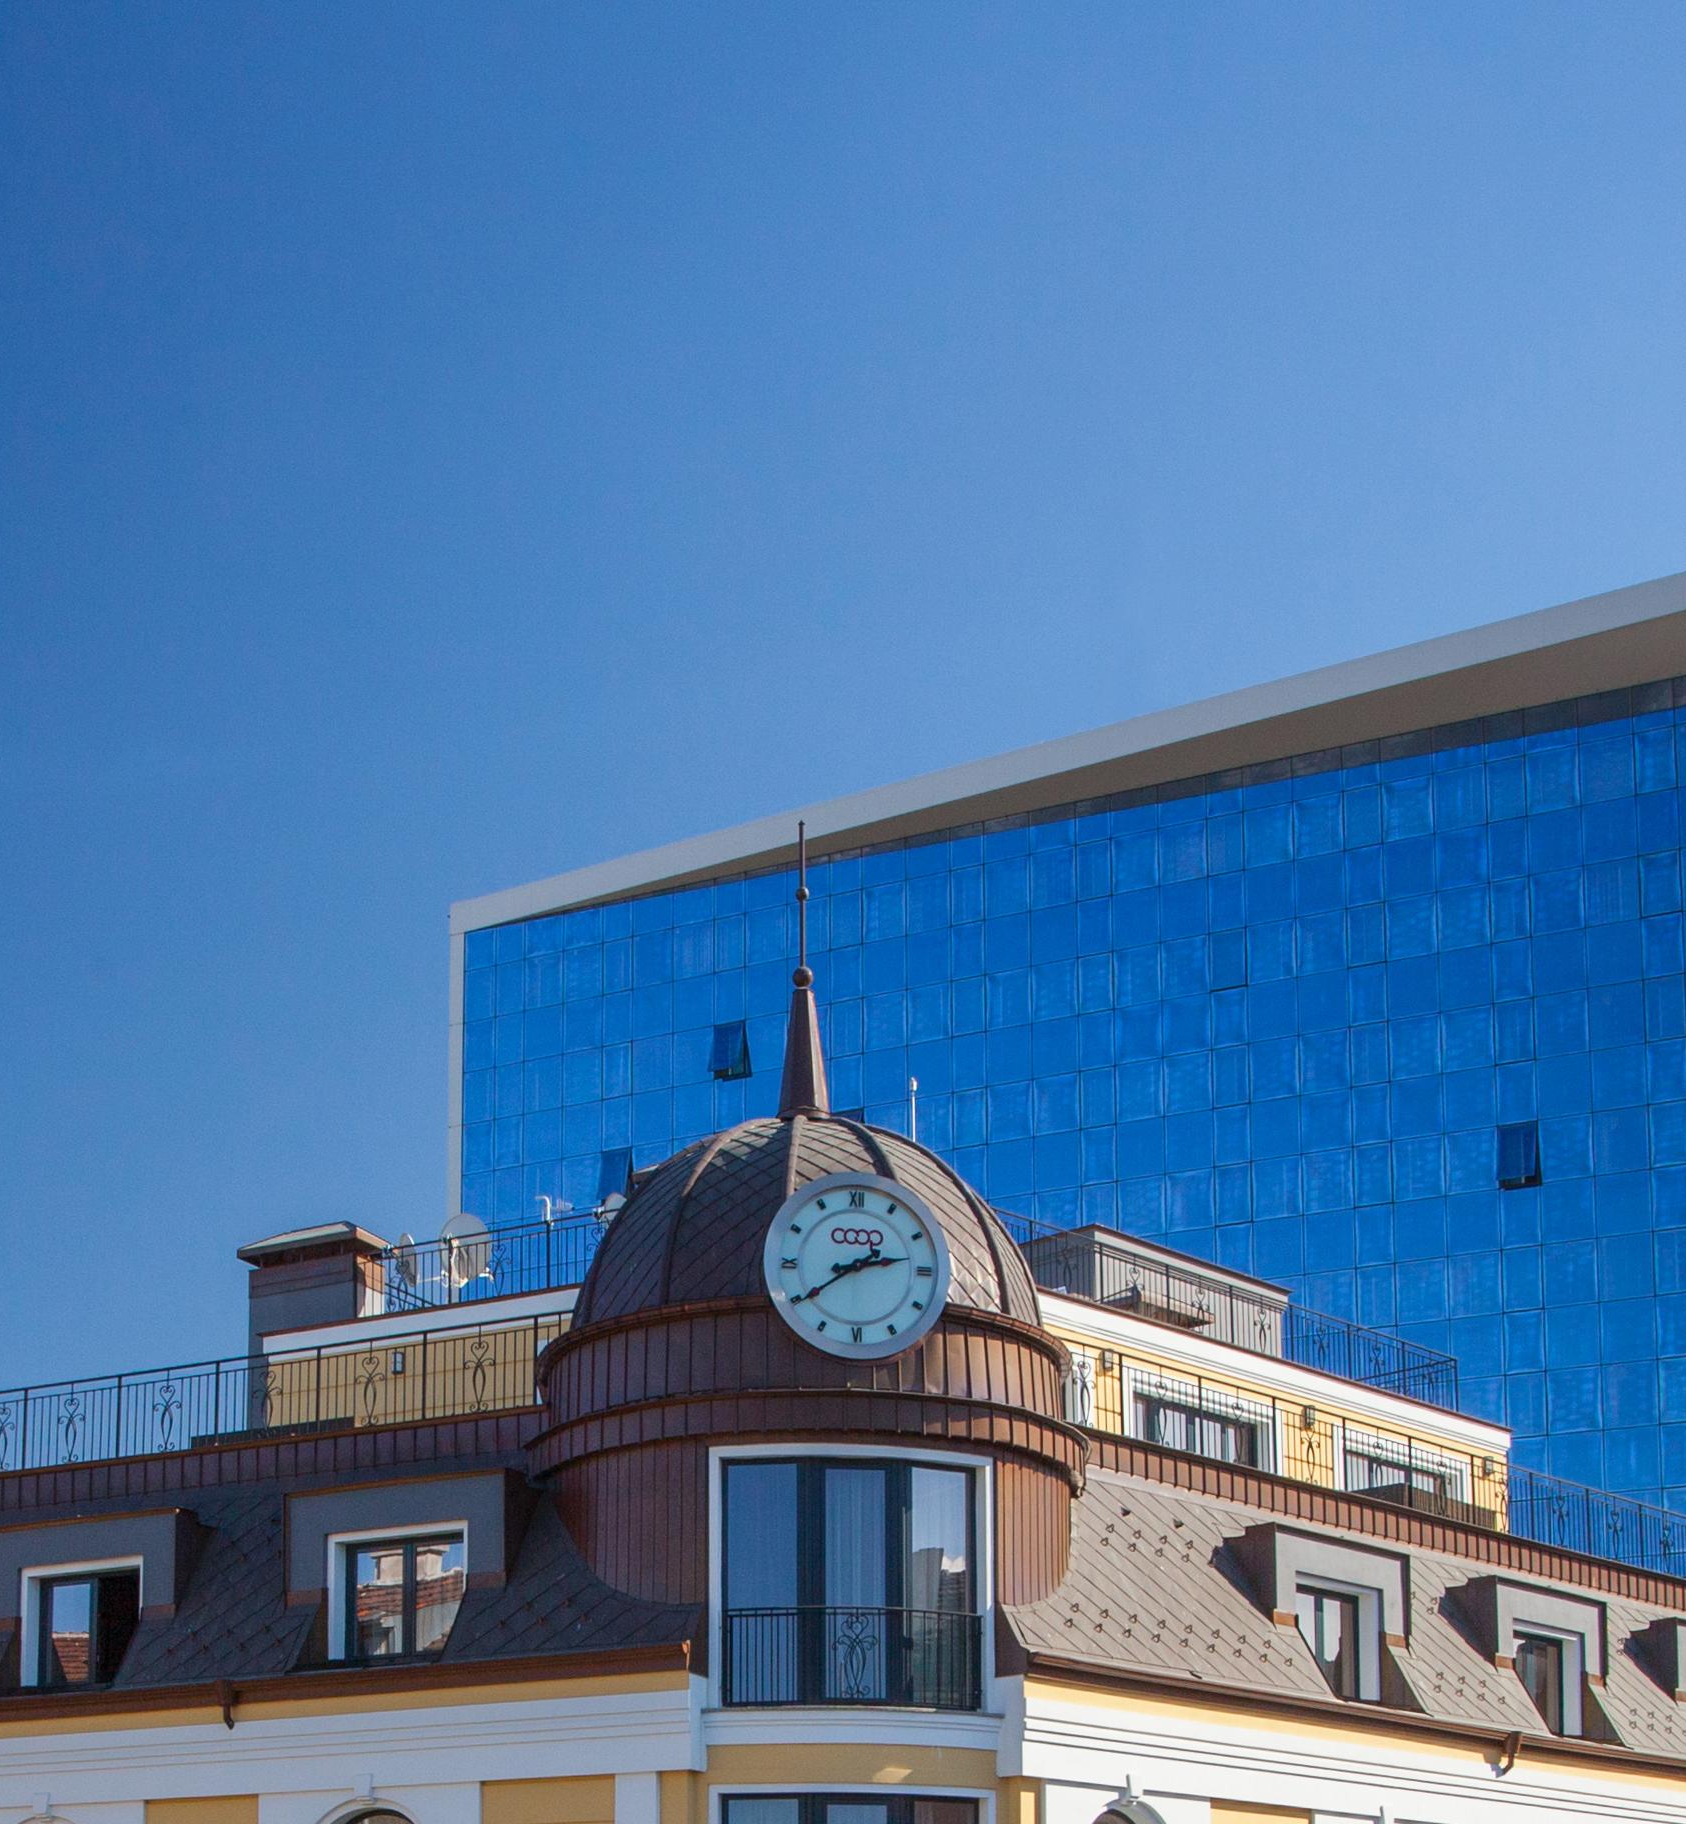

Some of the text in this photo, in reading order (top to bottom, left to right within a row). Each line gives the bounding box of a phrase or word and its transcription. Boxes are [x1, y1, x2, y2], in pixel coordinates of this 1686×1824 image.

[849, 1191, 865, 1208] XII
[831, 1227, 883, 1251] coop
[851, 1326, 863, 1343] VI
